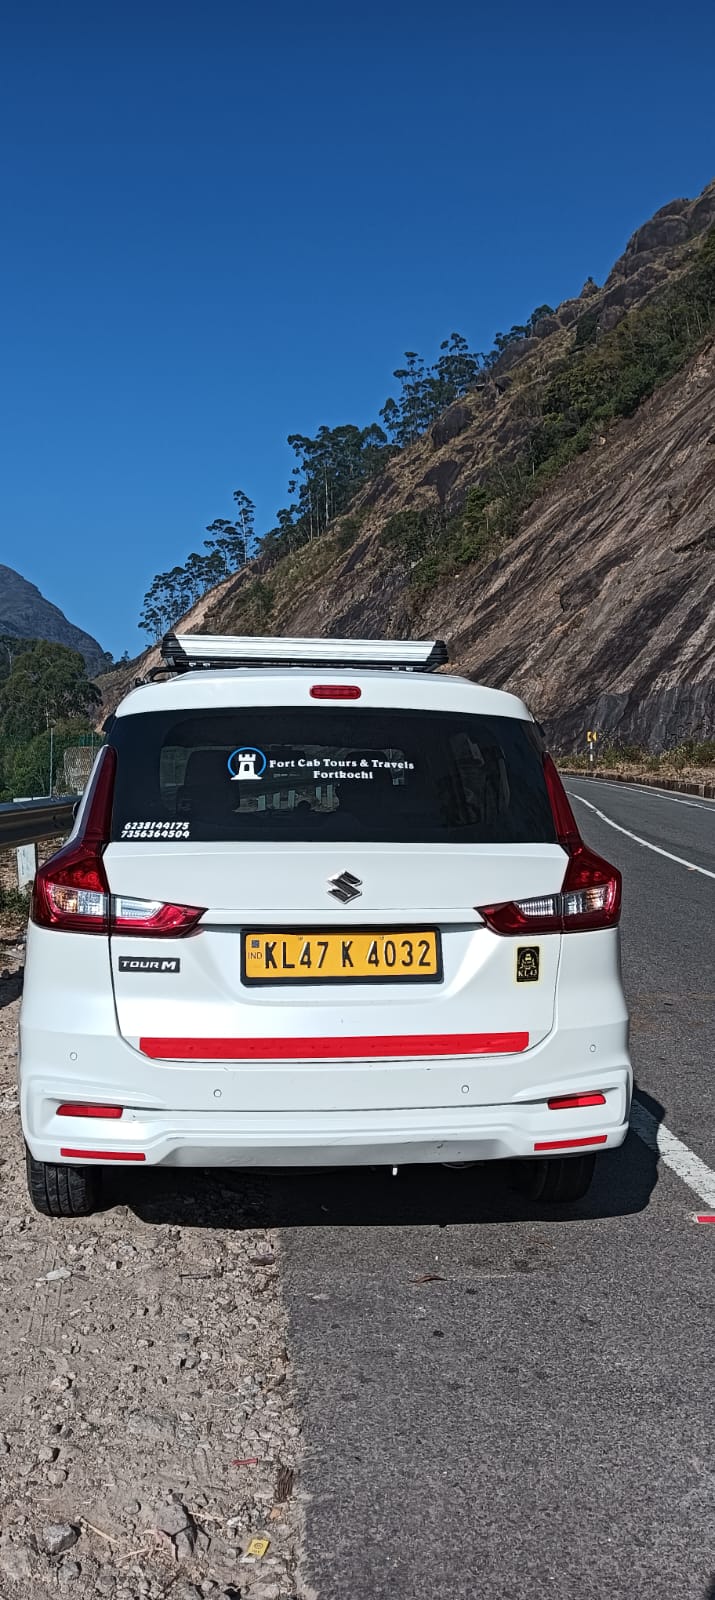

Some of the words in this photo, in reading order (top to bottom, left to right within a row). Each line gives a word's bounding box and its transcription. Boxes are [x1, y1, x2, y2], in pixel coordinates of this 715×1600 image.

[269, 759, 295, 768] Fort
[297, 758, 321, 767] Cab
[323, 758, 357, 767] Tours
[359, 759, 369, 767] &
[371, 759, 415, 770] Travels
[121, 830, 190, 838] 7356364504
[247, 951, 263, 960] IND
[264, 941, 329, 969] KL47
[341, 940, 354, 967] K
[367, 940, 431, 967] 4032
[121, 960, 159, 969] TOUR
[161, 961, 177, 970] M
